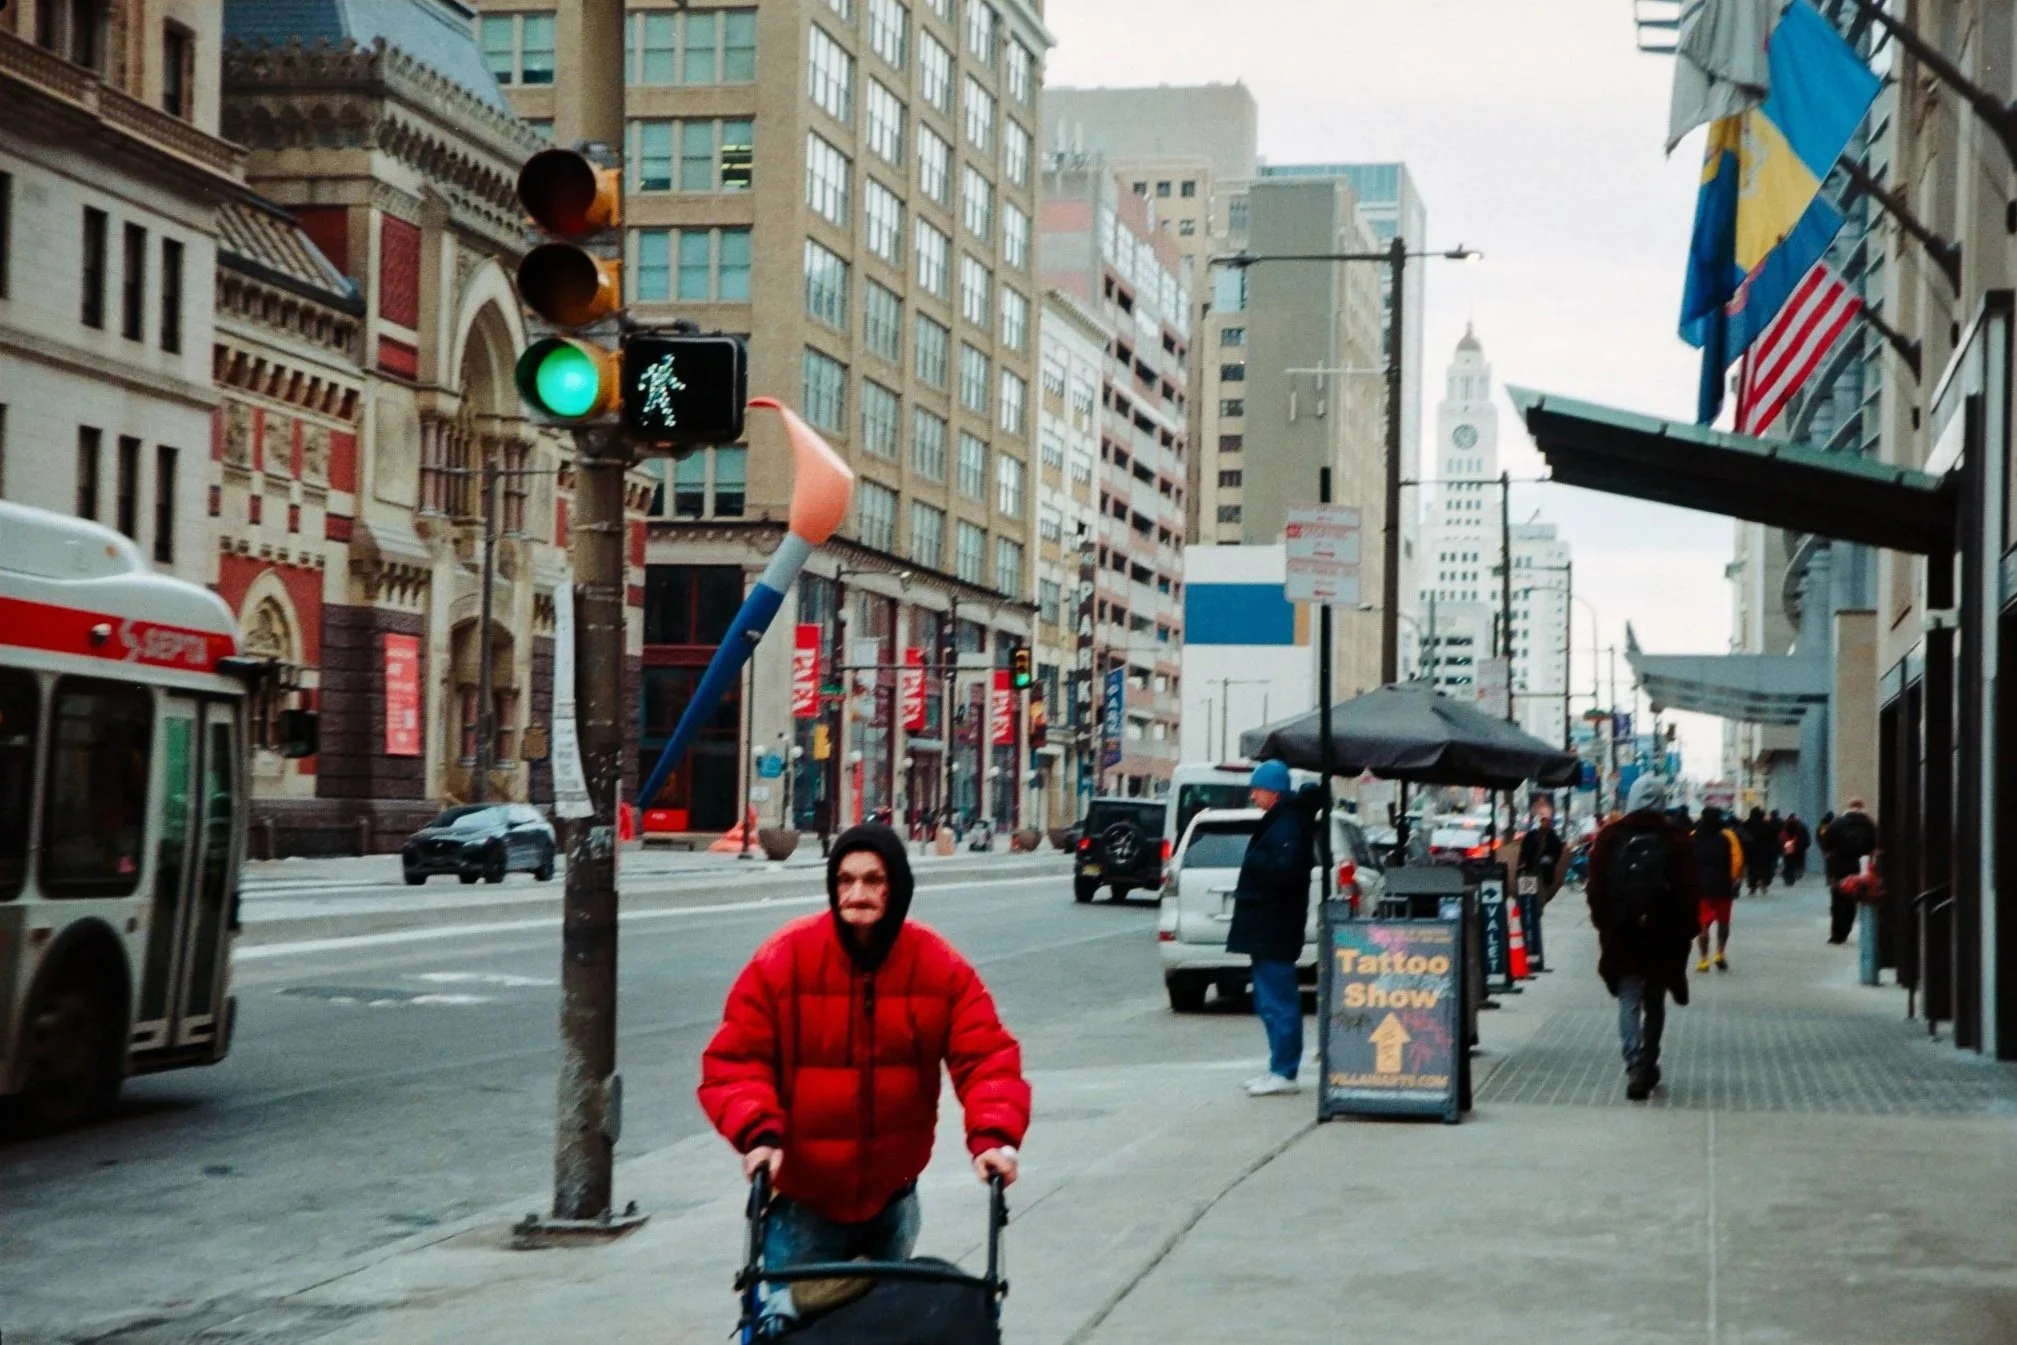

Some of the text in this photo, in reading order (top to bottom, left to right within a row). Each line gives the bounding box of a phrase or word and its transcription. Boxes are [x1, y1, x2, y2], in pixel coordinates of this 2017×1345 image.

[791, 648, 817, 714] PAFA
[901, 668, 924, 728] PAFA
[991, 690, 1012, 741] PAFA
[1335, 948, 1450, 976] Tattoo
[1486, 904, 1499, 972] VALET
[1343, 982, 1440, 1009] Show
